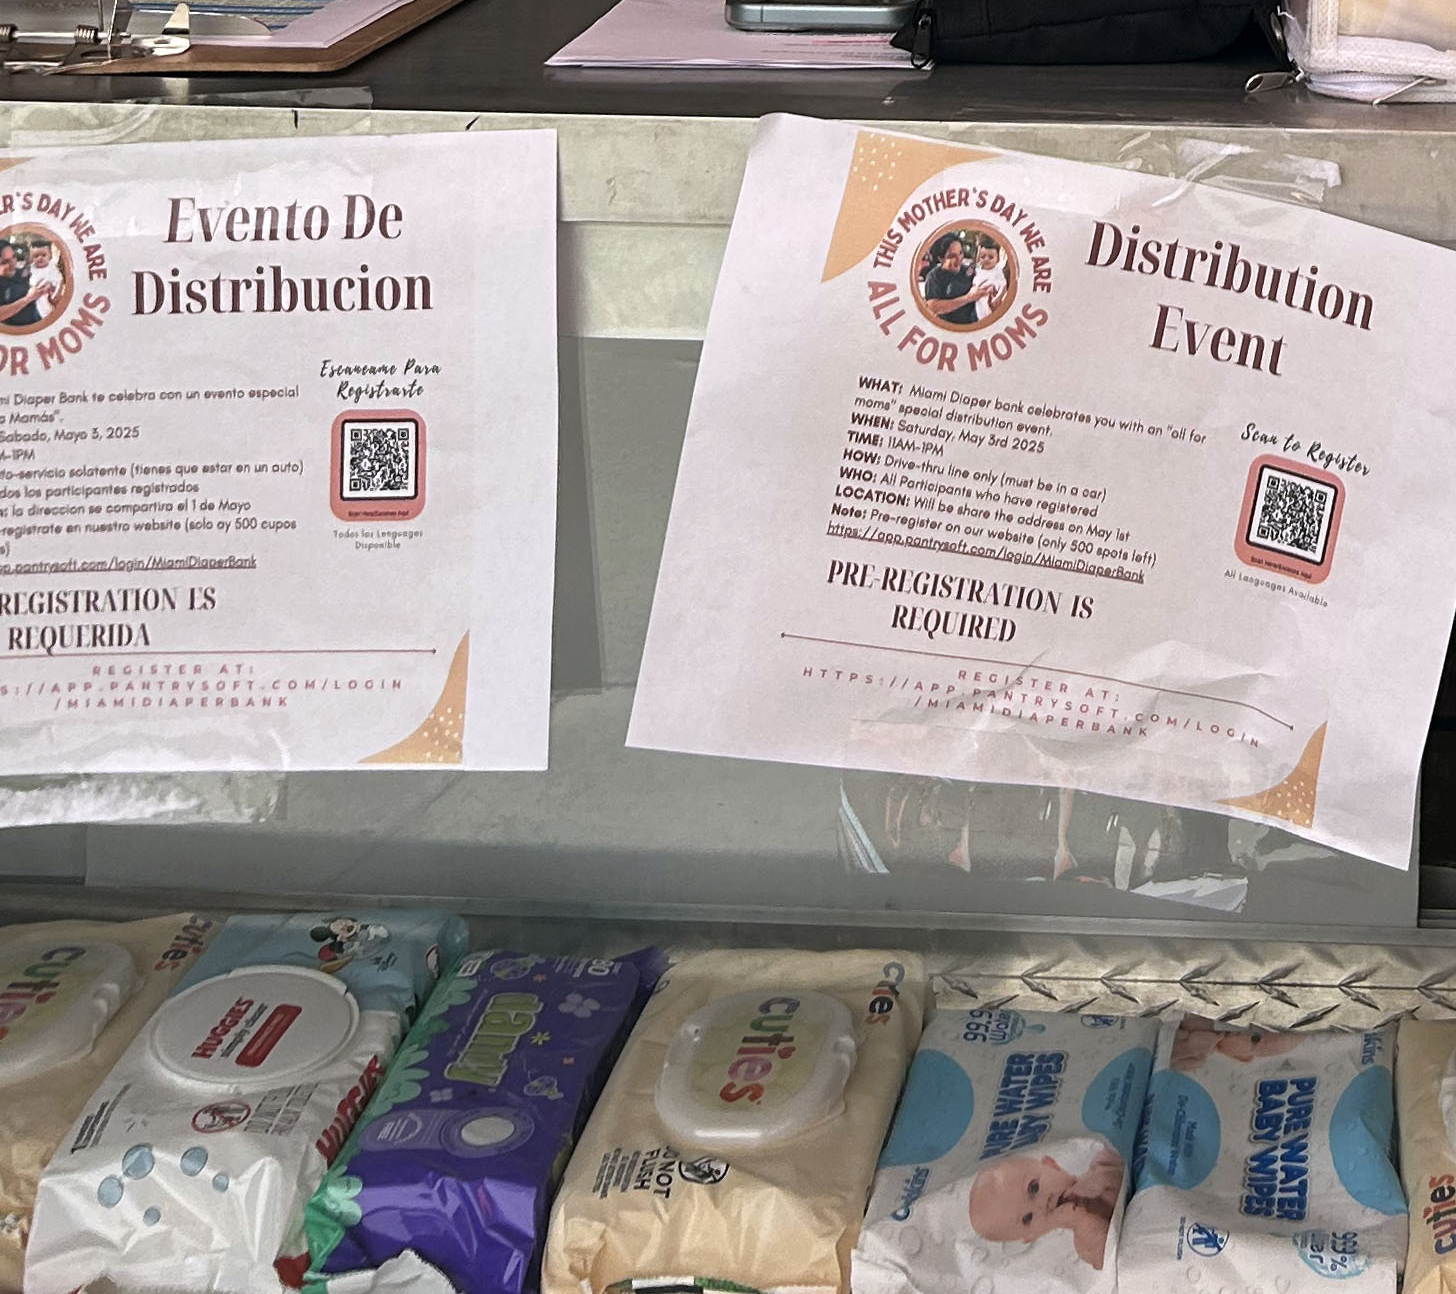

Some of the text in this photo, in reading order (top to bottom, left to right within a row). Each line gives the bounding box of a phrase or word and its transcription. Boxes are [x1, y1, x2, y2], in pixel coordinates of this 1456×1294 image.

[37, 193, 107, 282] DAY ARE
[163, 194, 402, 244] Evento De
[873, 187, 1052, 293] THIS MOTHER'S DAY WE ARE
[132, 264, 434, 315] Distribucion
[1084, 220, 1374, 331] Distribution
[38, 292, 111, 371] MOMS
[868, 281, 1048, 372] ALL FOR MOMS
[1149, 303, 1288, 376] Event
[337, 379, 424, 403] Registrarte
[404, 358, 441, 375] Para
[14, 385, 300, 409] Diaper Bank celebra evento especial
[859, 376, 1206, 443] WHAT: Miami Diaper bank celebrates you with an for
[899, 404, 1012, 429] special distribution
[54, 426, 139, 442] Mayo 2025
[848, 430, 943, 456] TIME: 11AM-1PM
[851, 412, 1044, 453] WHEN: Saturday, May 3rd 2025
[1241, 422, 1370, 476] Scan to Register
[46, 481, 200, 501] participantes registrados
[272, 460, 304, 475] auto)
[840, 466, 1098, 518] WHO: All Participants who have registered
[843, 448, 1106, 502] HOW: Drive-thru line only (must be in car)
[28, 501, 251, 517] direccion compartira Mayo
[85, 517, 297, 533] nuestro website 500 cupos
[835, 485, 1112, 542] LOCATION: Will be share the address on May
[832, 503, 1157, 568] Note: Pre-register on our website (only 500 spots left)
[190, 587, 217, 611] ES
[827, 559, 1094, 620] PRE-REGISTRATION IS
[8, 623, 151, 655] REQUERIDA
[891, 604, 1018, 642] REQUIRED
[93, 665, 202, 676] REGISTER
[958, 669, 1070, 695] REGISTER
[192, 996, 254, 1059] HUGGIES
[719, 997, 800, 1105] cuties
[993, 1053, 1035, 1117] WATER
[1024, 1052, 1066, 1111] WIPES
[633, 1148, 661, 1191] FLUSH
[1240, 1080, 1289, 1217] BABY WIPES
[1277, 1077, 1317, 1221] PURE WATER
